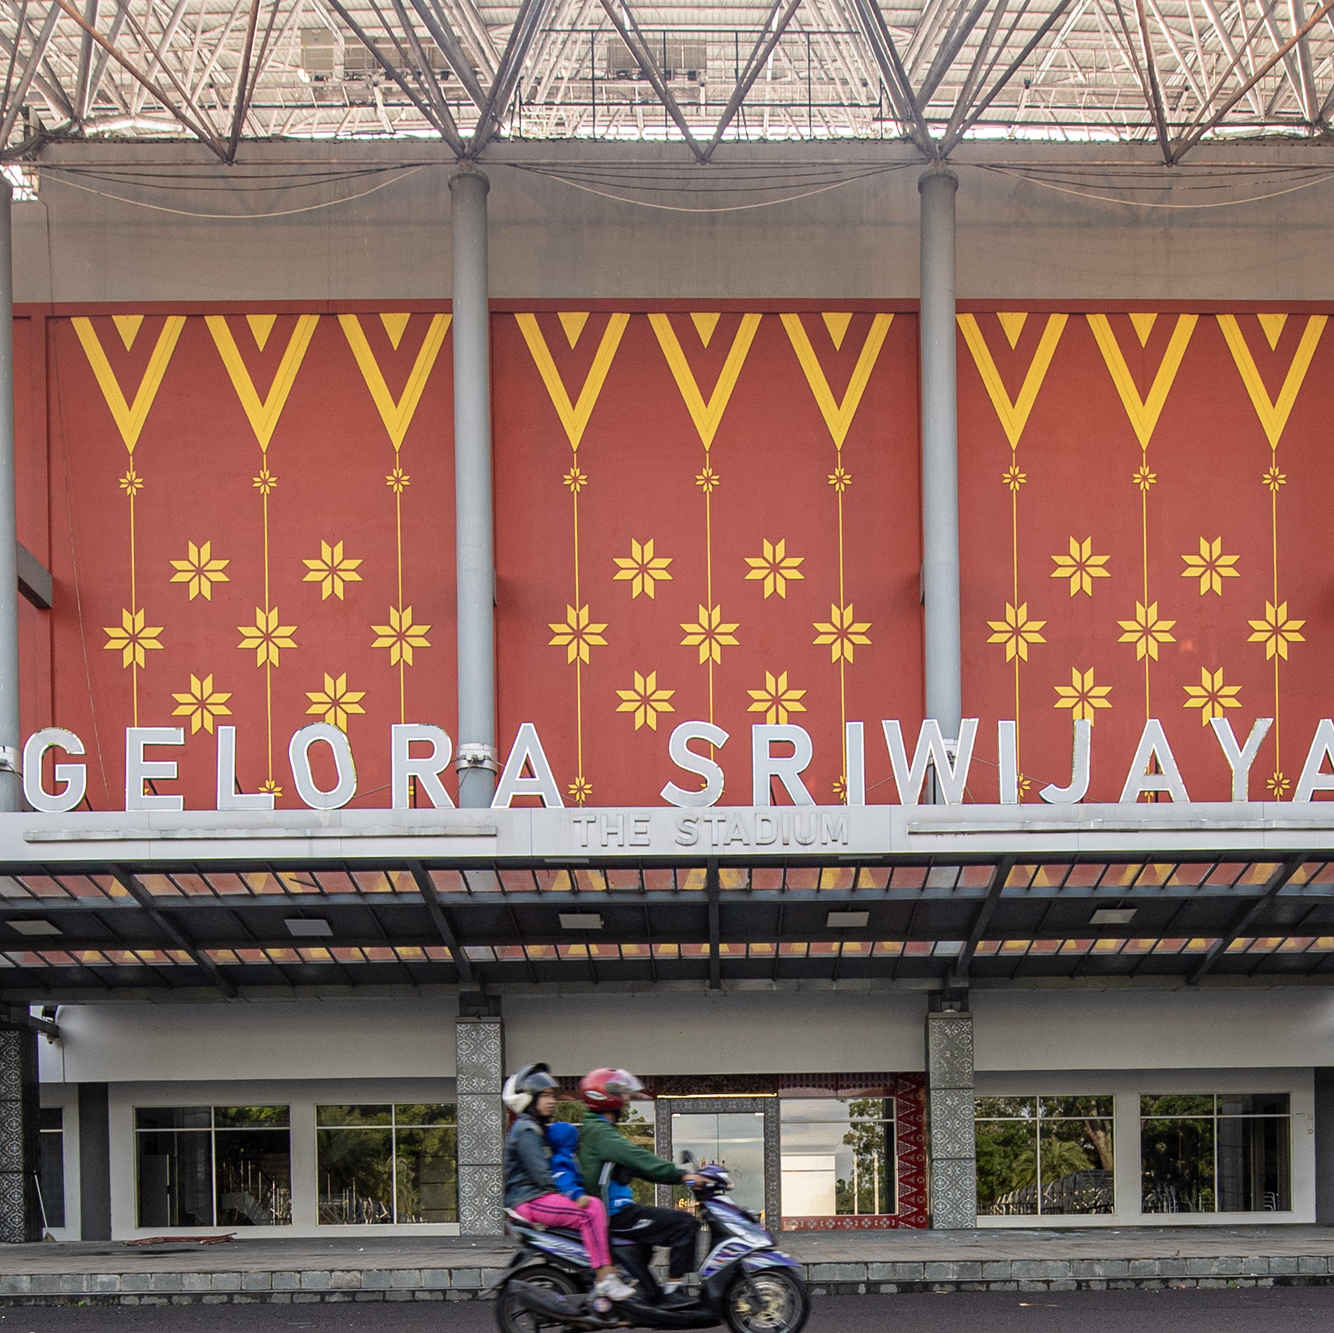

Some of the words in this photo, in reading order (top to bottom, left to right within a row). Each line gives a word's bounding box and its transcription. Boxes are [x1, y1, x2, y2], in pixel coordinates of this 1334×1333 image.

[22, 721, 565, 813] GELORA
[573, 814, 650, 848] THE
[674, 813, 849, 847] STADIUM
